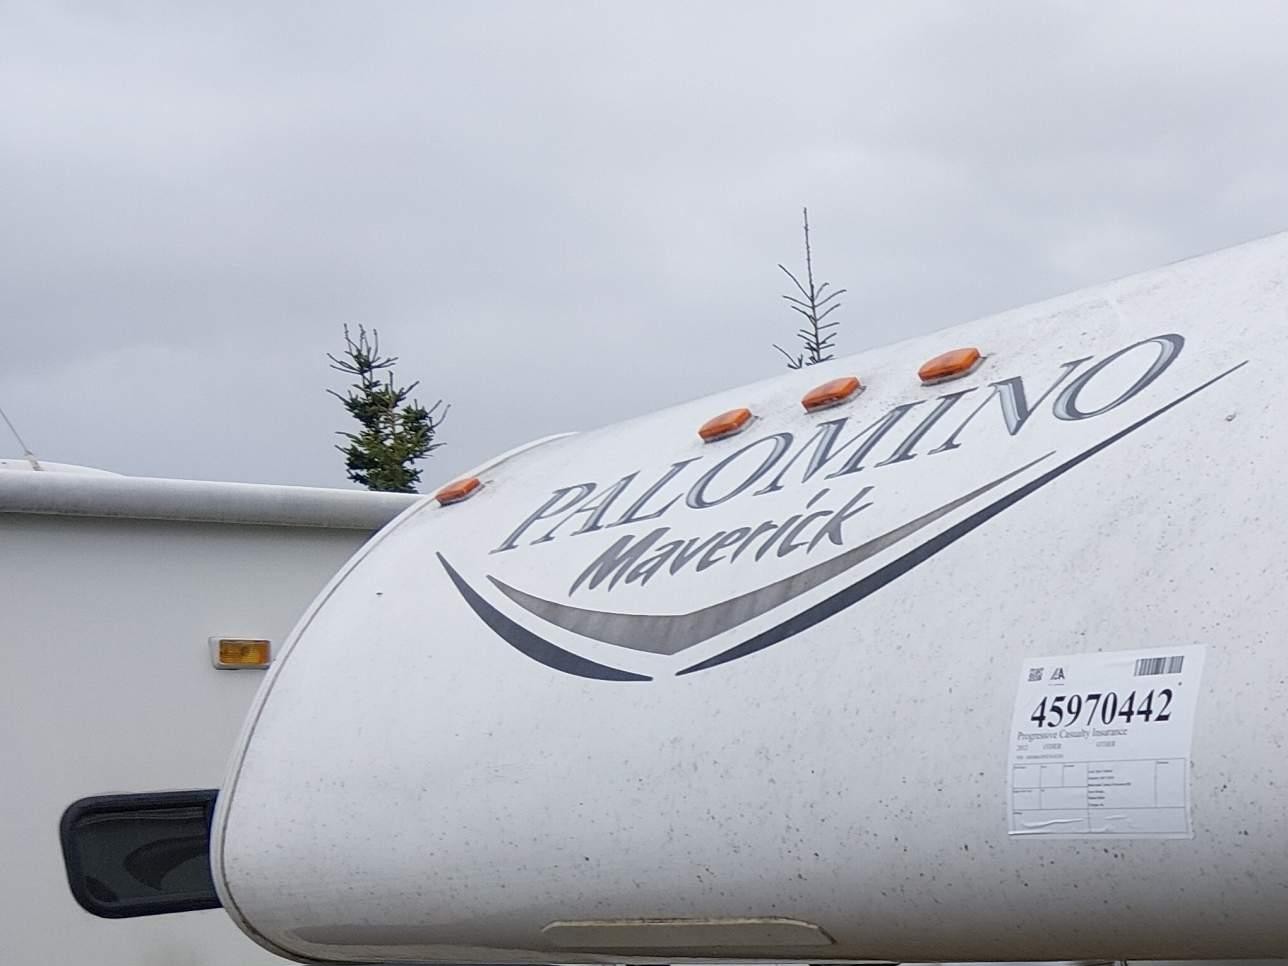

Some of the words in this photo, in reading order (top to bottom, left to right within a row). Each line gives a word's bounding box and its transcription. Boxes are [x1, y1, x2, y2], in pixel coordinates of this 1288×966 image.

[490, 333, 1186, 555] PALOMINO
[568, 486, 874, 597] Maverick
[1030, 688, 1173, 728] 45970442
[1092, 727, 1128, 737] Insurance
